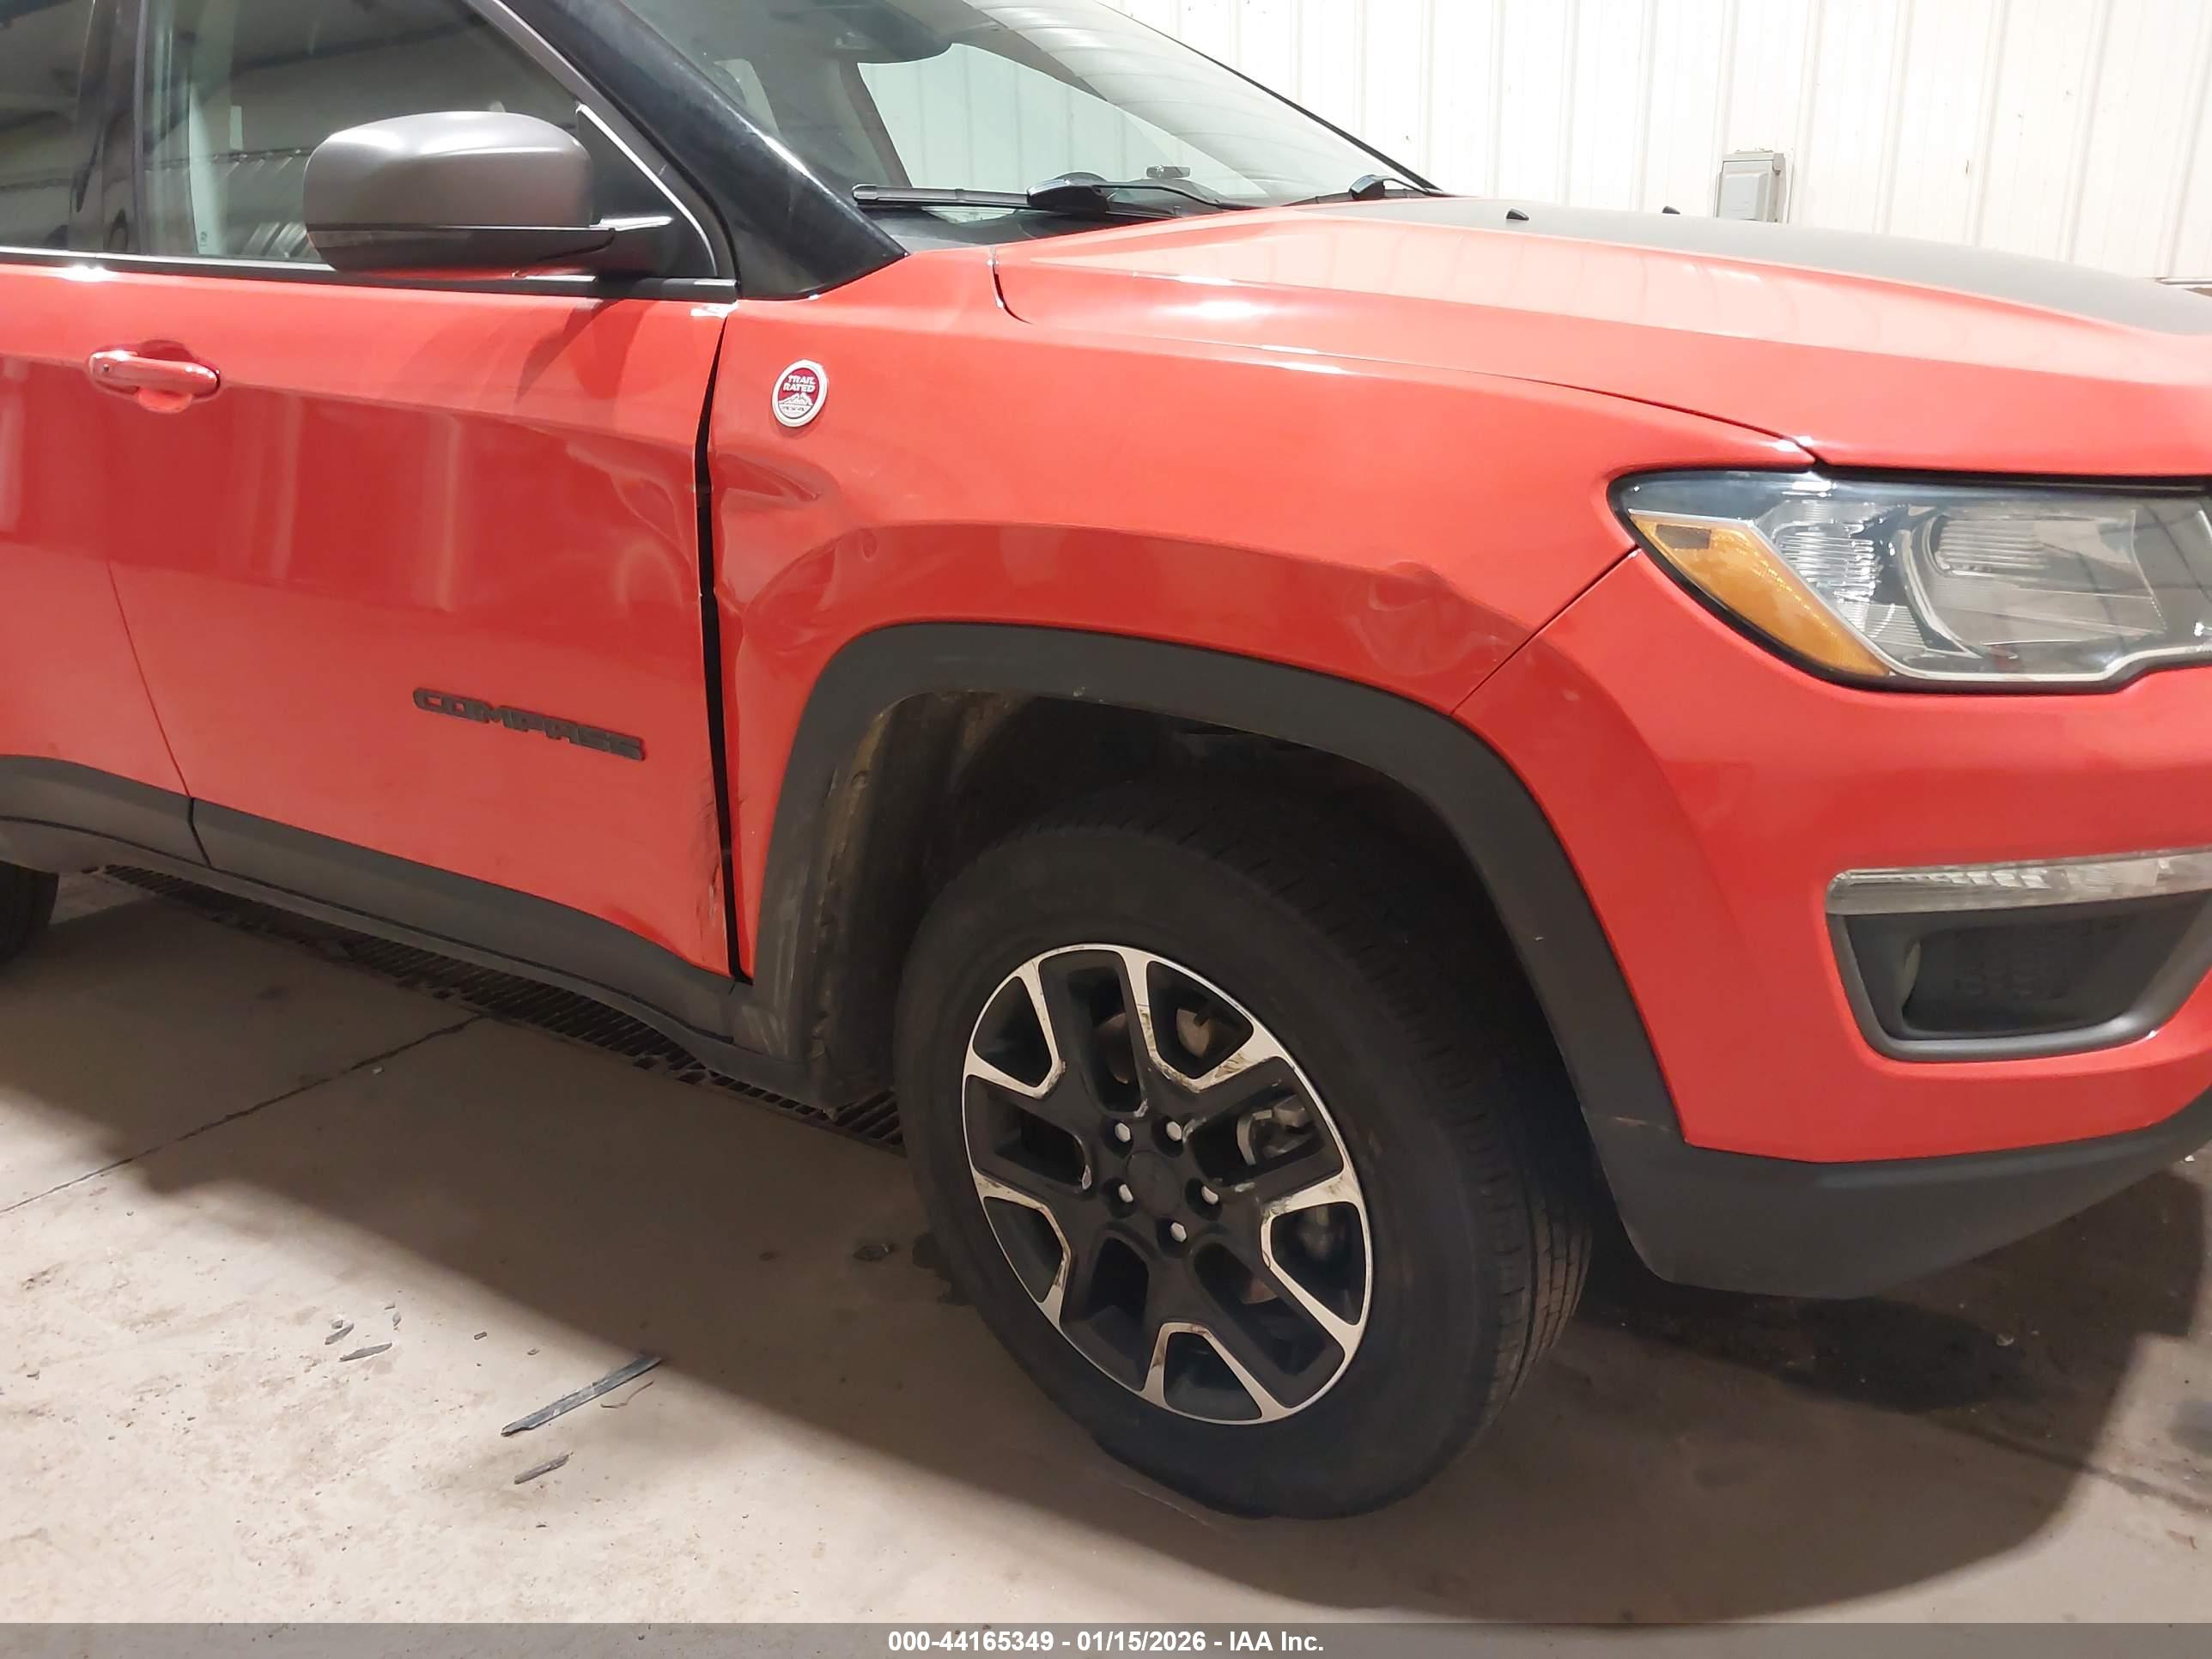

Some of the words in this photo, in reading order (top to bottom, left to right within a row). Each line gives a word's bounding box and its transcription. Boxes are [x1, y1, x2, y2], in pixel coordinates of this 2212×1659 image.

[787, 374, 817, 385] TRAIL
[782, 382, 816, 393] RATED
[412, 687, 646, 761] COMPASS
